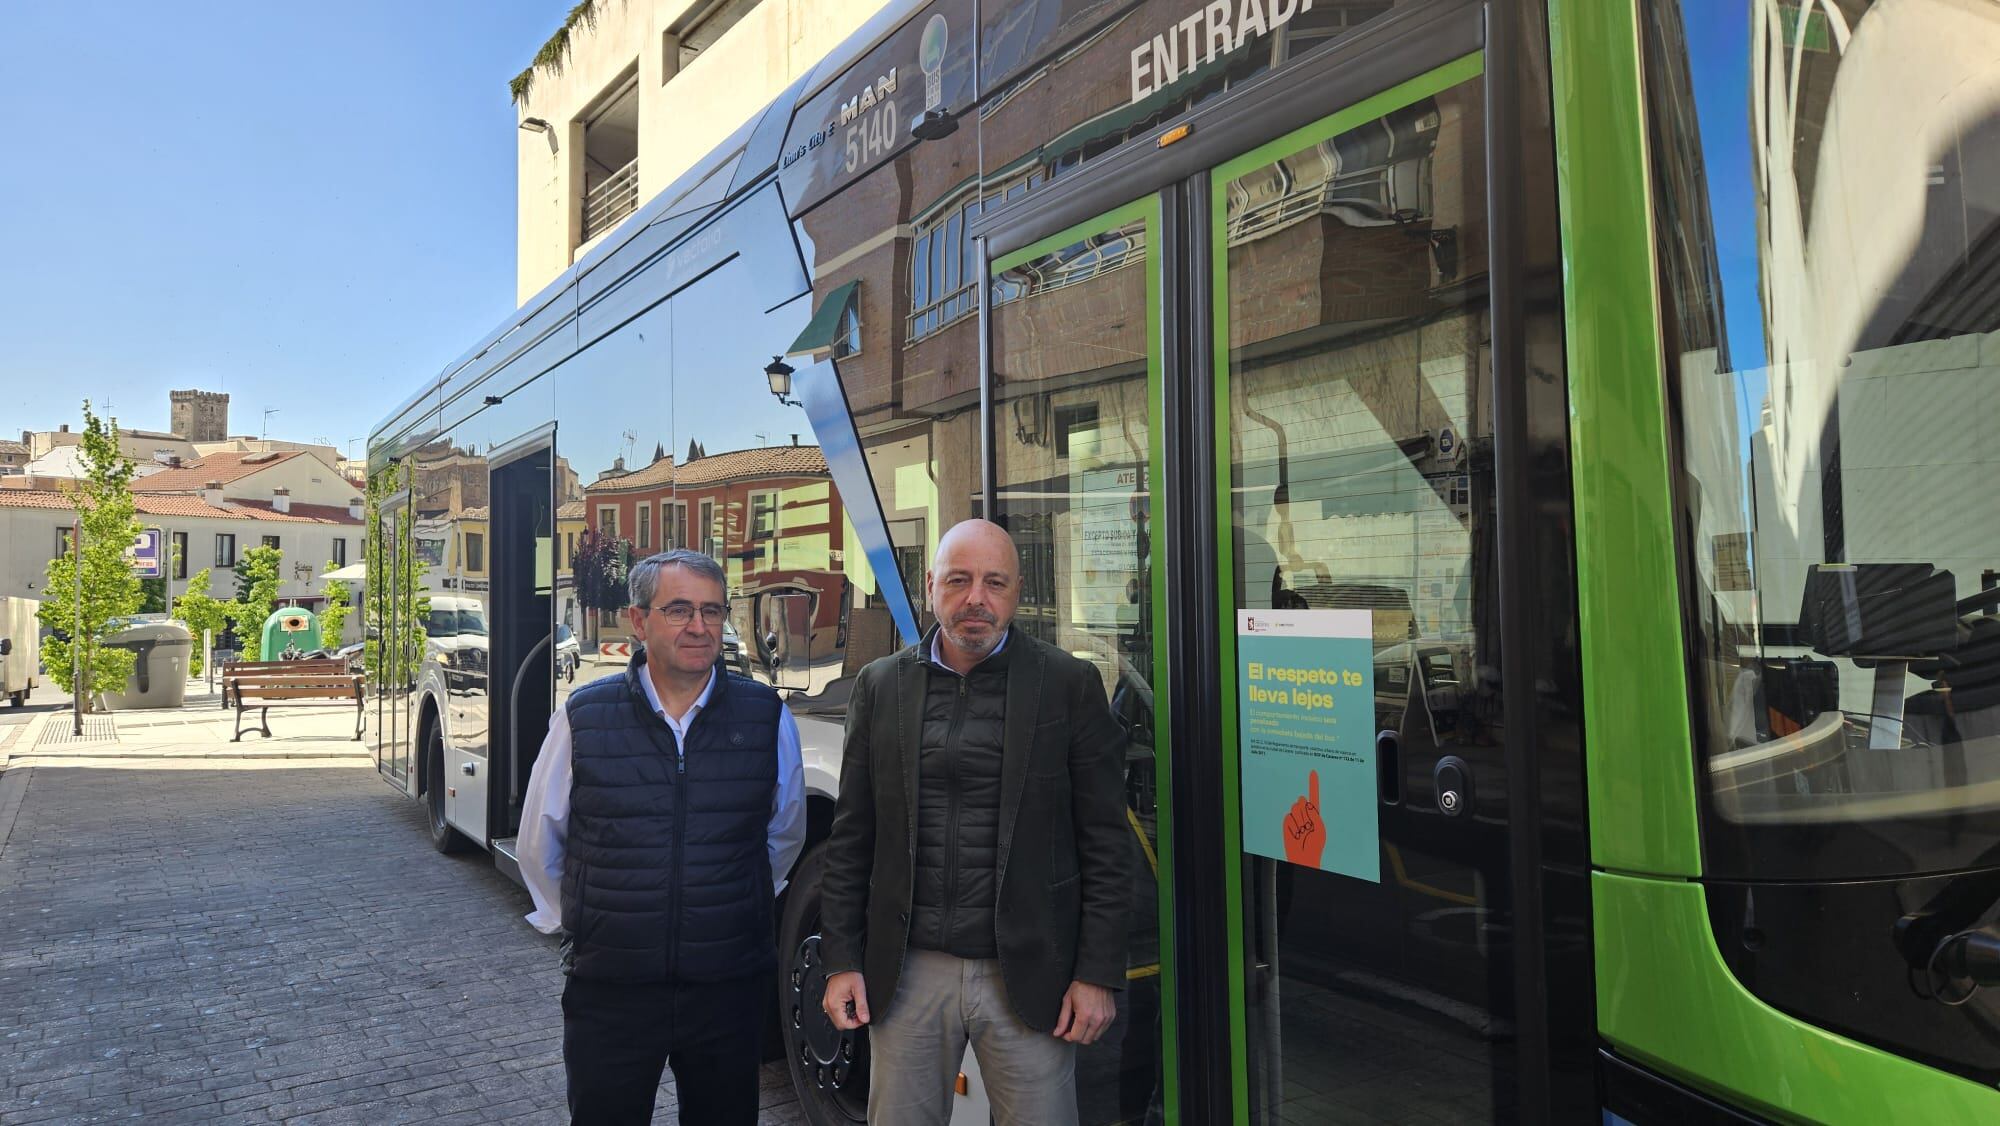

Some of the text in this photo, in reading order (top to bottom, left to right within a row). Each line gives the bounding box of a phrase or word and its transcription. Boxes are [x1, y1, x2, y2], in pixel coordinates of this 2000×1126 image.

[927, 69, 940, 88] BUS
[841, 67, 897, 127] MAN
[809, 131, 826, 151] City
[828, 121, 836, 138] E
[845, 100, 897, 173] 5140
[1248, 662, 1362, 687] El respeto te
[1249, 685, 1334, 710] lleva lejos
